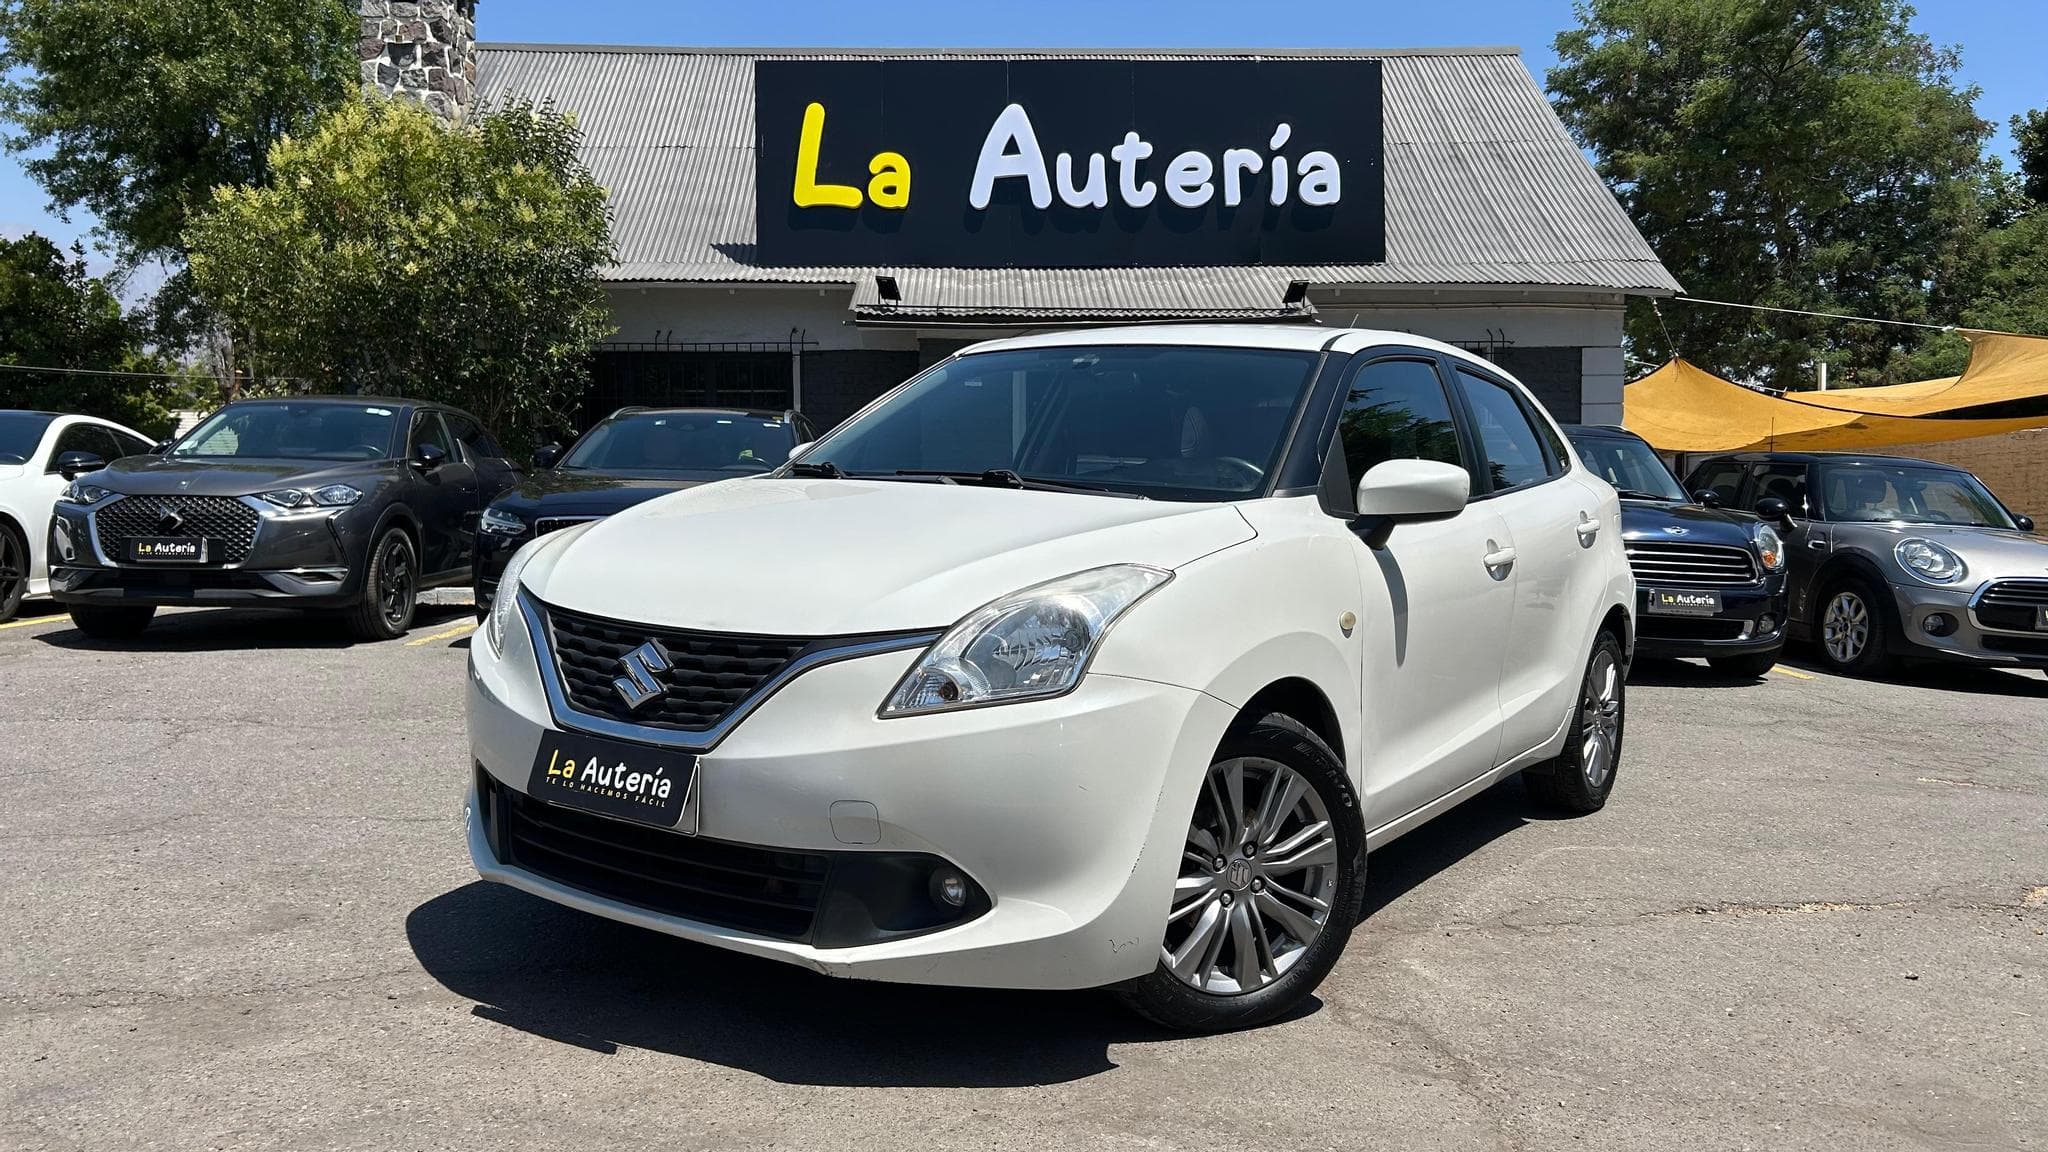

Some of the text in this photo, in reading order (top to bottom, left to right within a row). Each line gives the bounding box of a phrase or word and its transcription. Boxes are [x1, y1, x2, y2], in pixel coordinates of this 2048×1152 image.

[793, 102, 1341, 210] La Autería
[138, 542, 151, 552] La
[1661, 593, 1673, 602] La
[548, 749, 672, 799] La Autería
[546, 776, 557, 785] TE
[580, 784, 627, 799] HACEMOS
